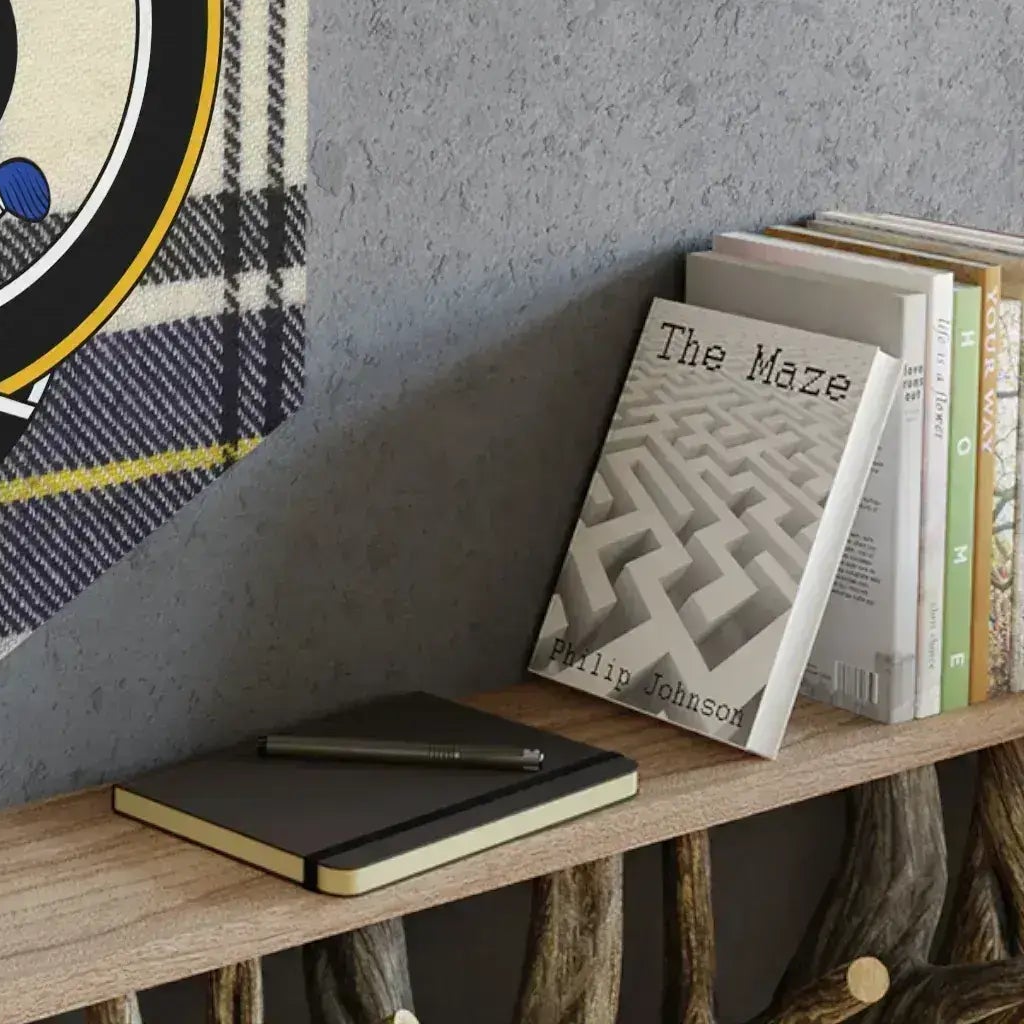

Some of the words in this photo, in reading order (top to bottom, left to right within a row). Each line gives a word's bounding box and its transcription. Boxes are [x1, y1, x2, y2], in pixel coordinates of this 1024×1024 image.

[656, 322, 726, 371] The
[746, 343, 851, 401] Maze
[934, 317, 950, 345] life
[936, 353, 945, 365] is
[984, 286, 998, 377] YOUR
[931, 386, 948, 439] flower
[982, 389, 994, 453] WAY
[549, 637, 631, 692] Philip
[644, 673, 745, 727] Johnson
